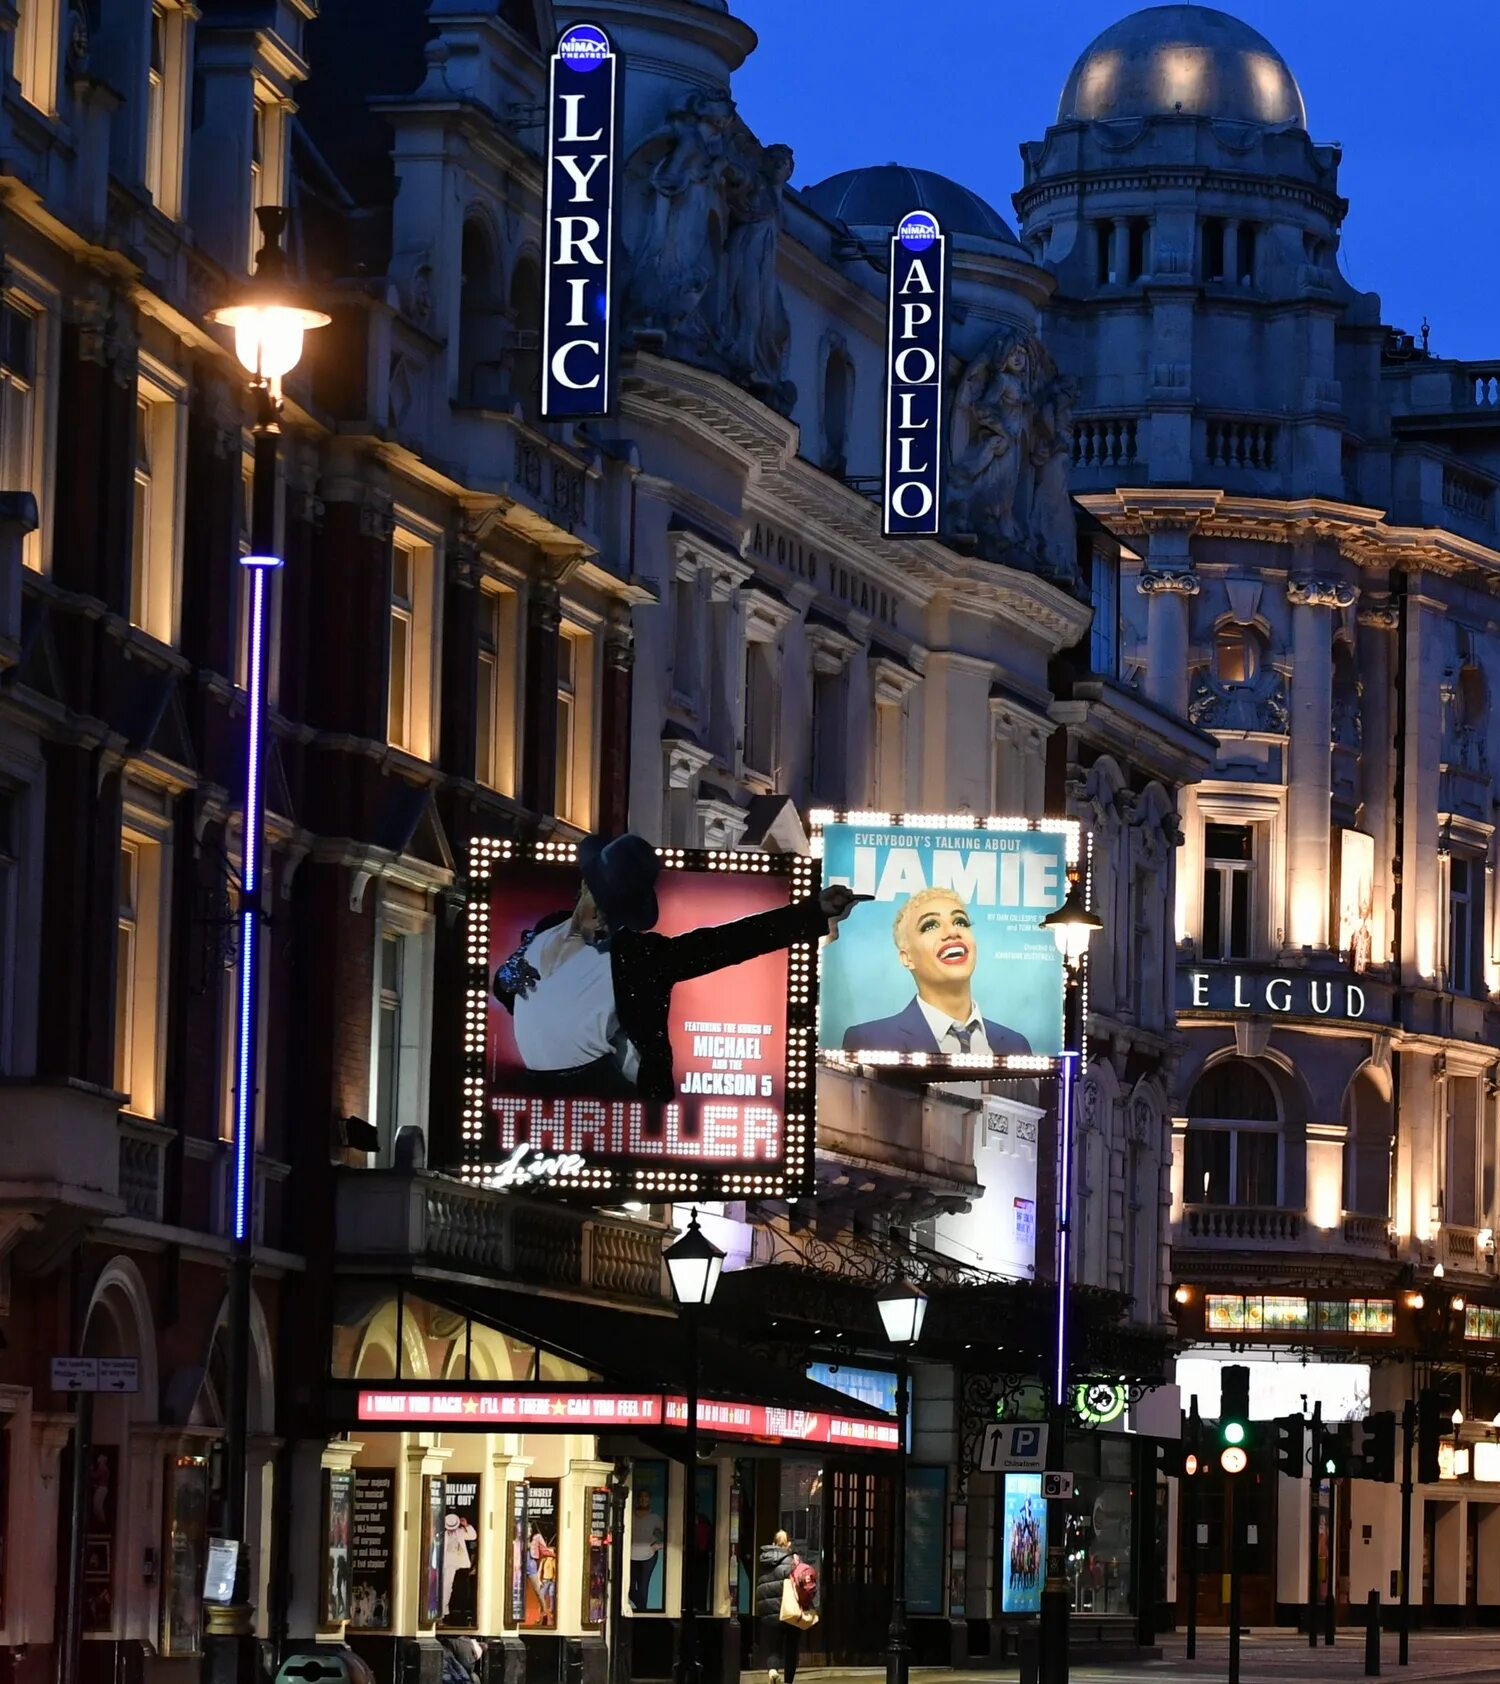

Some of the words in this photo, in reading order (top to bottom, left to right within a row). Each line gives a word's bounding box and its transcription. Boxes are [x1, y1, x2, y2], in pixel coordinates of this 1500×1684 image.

[561, 41, 606, 52] NIMAX
[551, 94, 608, 390] LYRIC
[901, 226, 935, 235] NIMAX
[892, 259, 936, 519] APOLLO
[754, 523, 817, 582] APOLLO
[829, 562, 898, 627] THEATRE
[855, 833, 931, 848] EVERYBODY'S
[935, 836, 980, 849] TALKING
[984, 839, 1021, 851] ABOUT
[828, 847, 1058, 908] JAMIE
[684, 1021, 722, 1033] FEATURING
[723, 1023, 737, 1033] THE
[763, 1024, 772, 1035] OF
[693, 1035, 762, 1059] MICHAEL
[712, 1059, 728, 1070] AND
[729, 1059, 743, 1070] THE
[680, 1071, 757, 1096] JACKSON
[761, 1075, 772, 1096] 5
[492, 1097, 779, 1158] THRILLER
[492, 1143, 586, 1190] Live
[367, 1395, 373, 1413] I
[374, 1395, 406, 1413] WANT
[408, 1396, 430, 1413] YOU
[480, 1397, 499, 1414] I'LL
[518, 1398, 551, 1415] THERE
[567, 1398, 590, 1416] CAN
[593, 1399, 614, 1416] YOU
[617, 1399, 639, 1416] FEEL
[642, 1400, 654, 1417] IT
[1016, 1430, 1034, 1454] P
